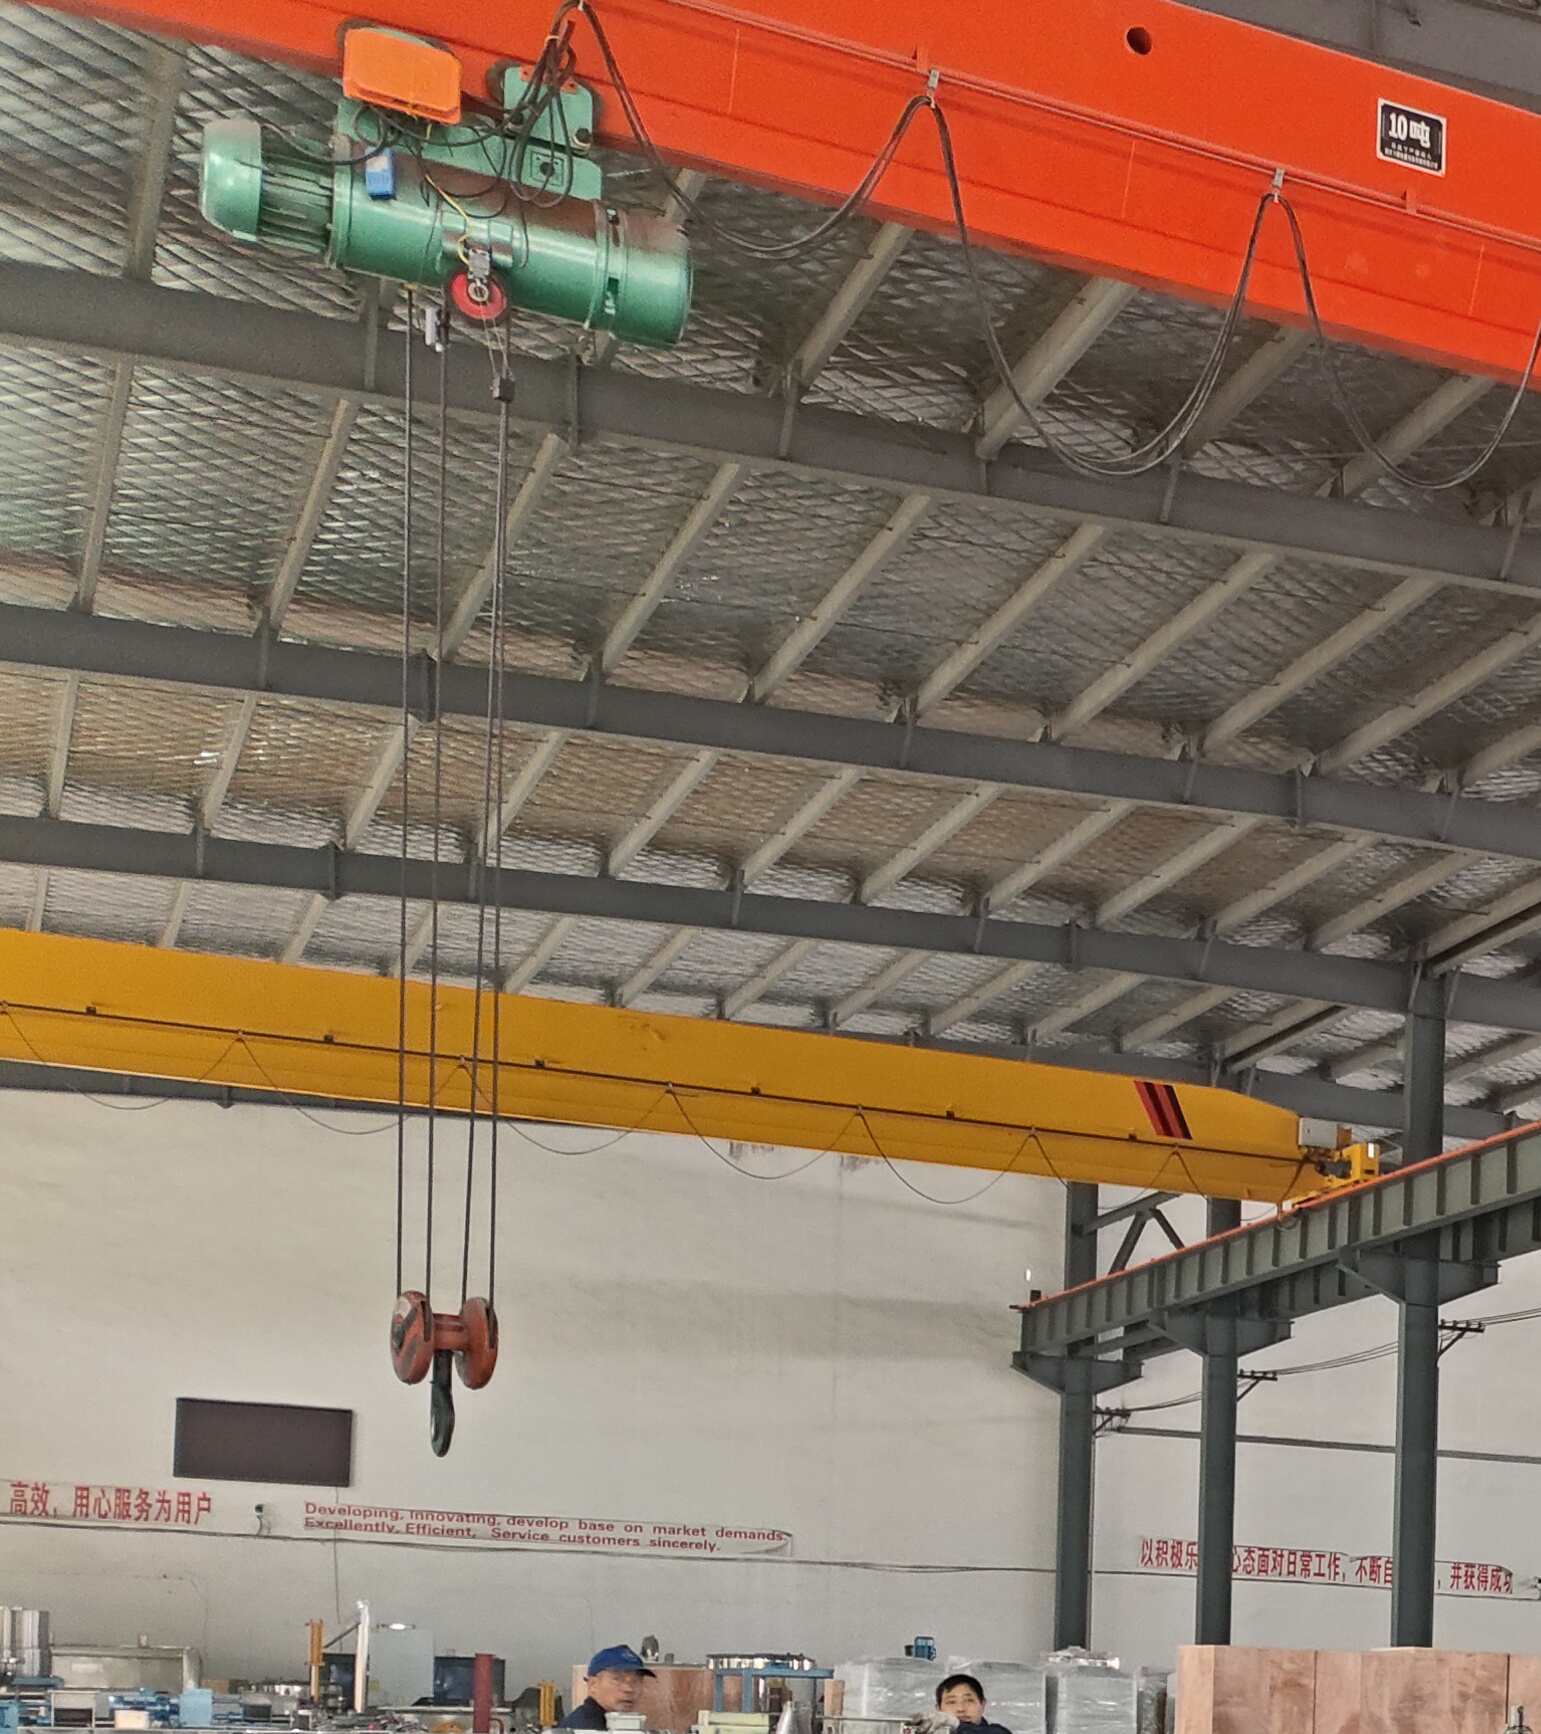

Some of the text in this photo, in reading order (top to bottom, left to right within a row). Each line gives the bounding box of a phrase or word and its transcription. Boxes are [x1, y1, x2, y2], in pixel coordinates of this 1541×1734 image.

[304, 1502, 404, 1521] Developing,
[506, 1516, 569, 1531] develop
[578, 1519, 614, 1532] base
[624, 1523, 643, 1533] on
[652, 1525, 707, 1538] market
[715, 1526, 787, 1542] demands.
[304, 1517, 721, 1553] Excellently, Efficient, Service customers sincerely.
